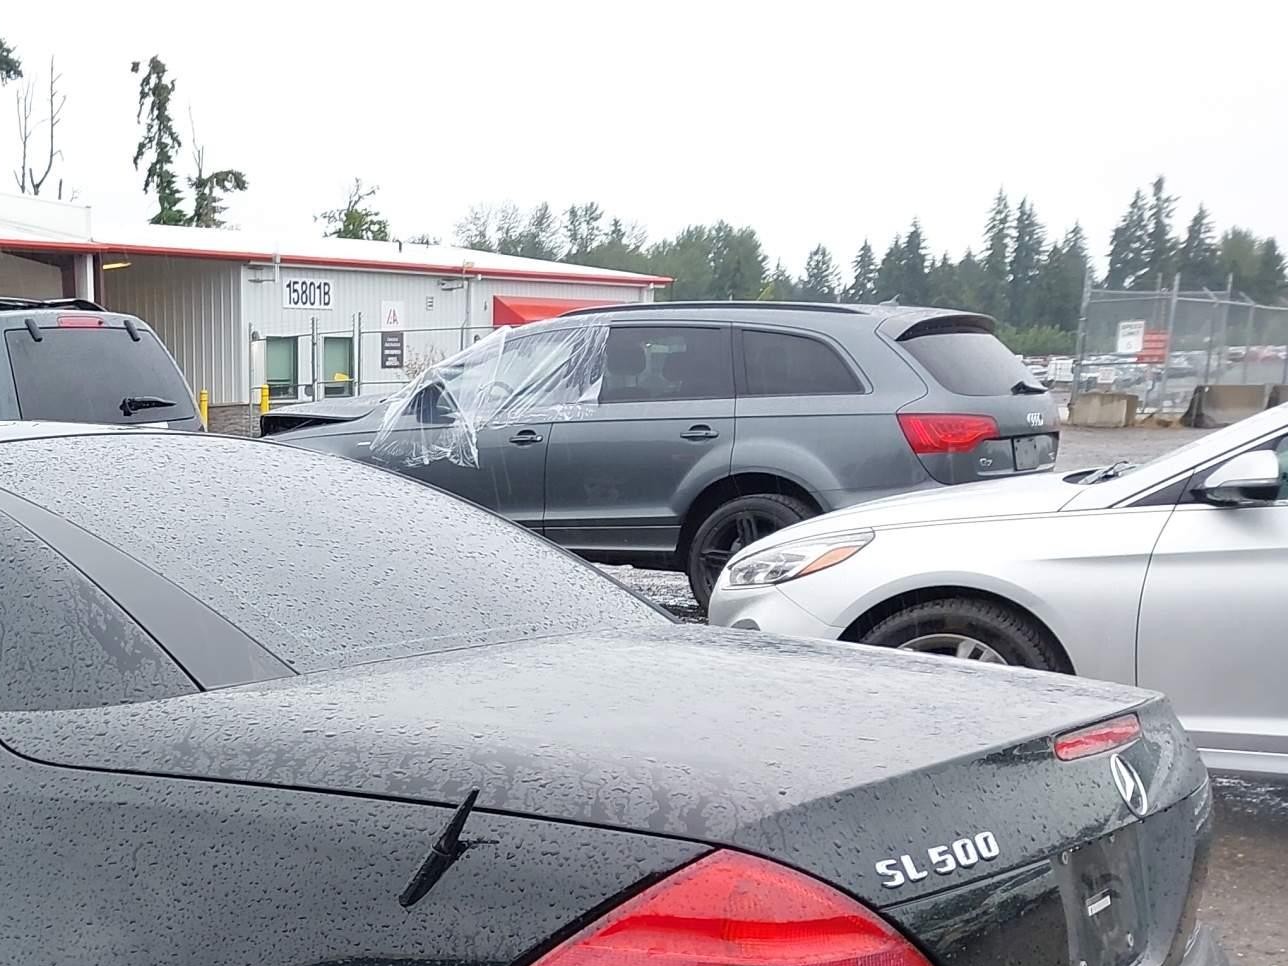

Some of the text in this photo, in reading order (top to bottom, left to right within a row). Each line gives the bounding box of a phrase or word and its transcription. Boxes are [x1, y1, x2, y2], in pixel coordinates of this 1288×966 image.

[285, 279, 331, 306] 15801B
[875, 831, 1001, 888] SL 500
